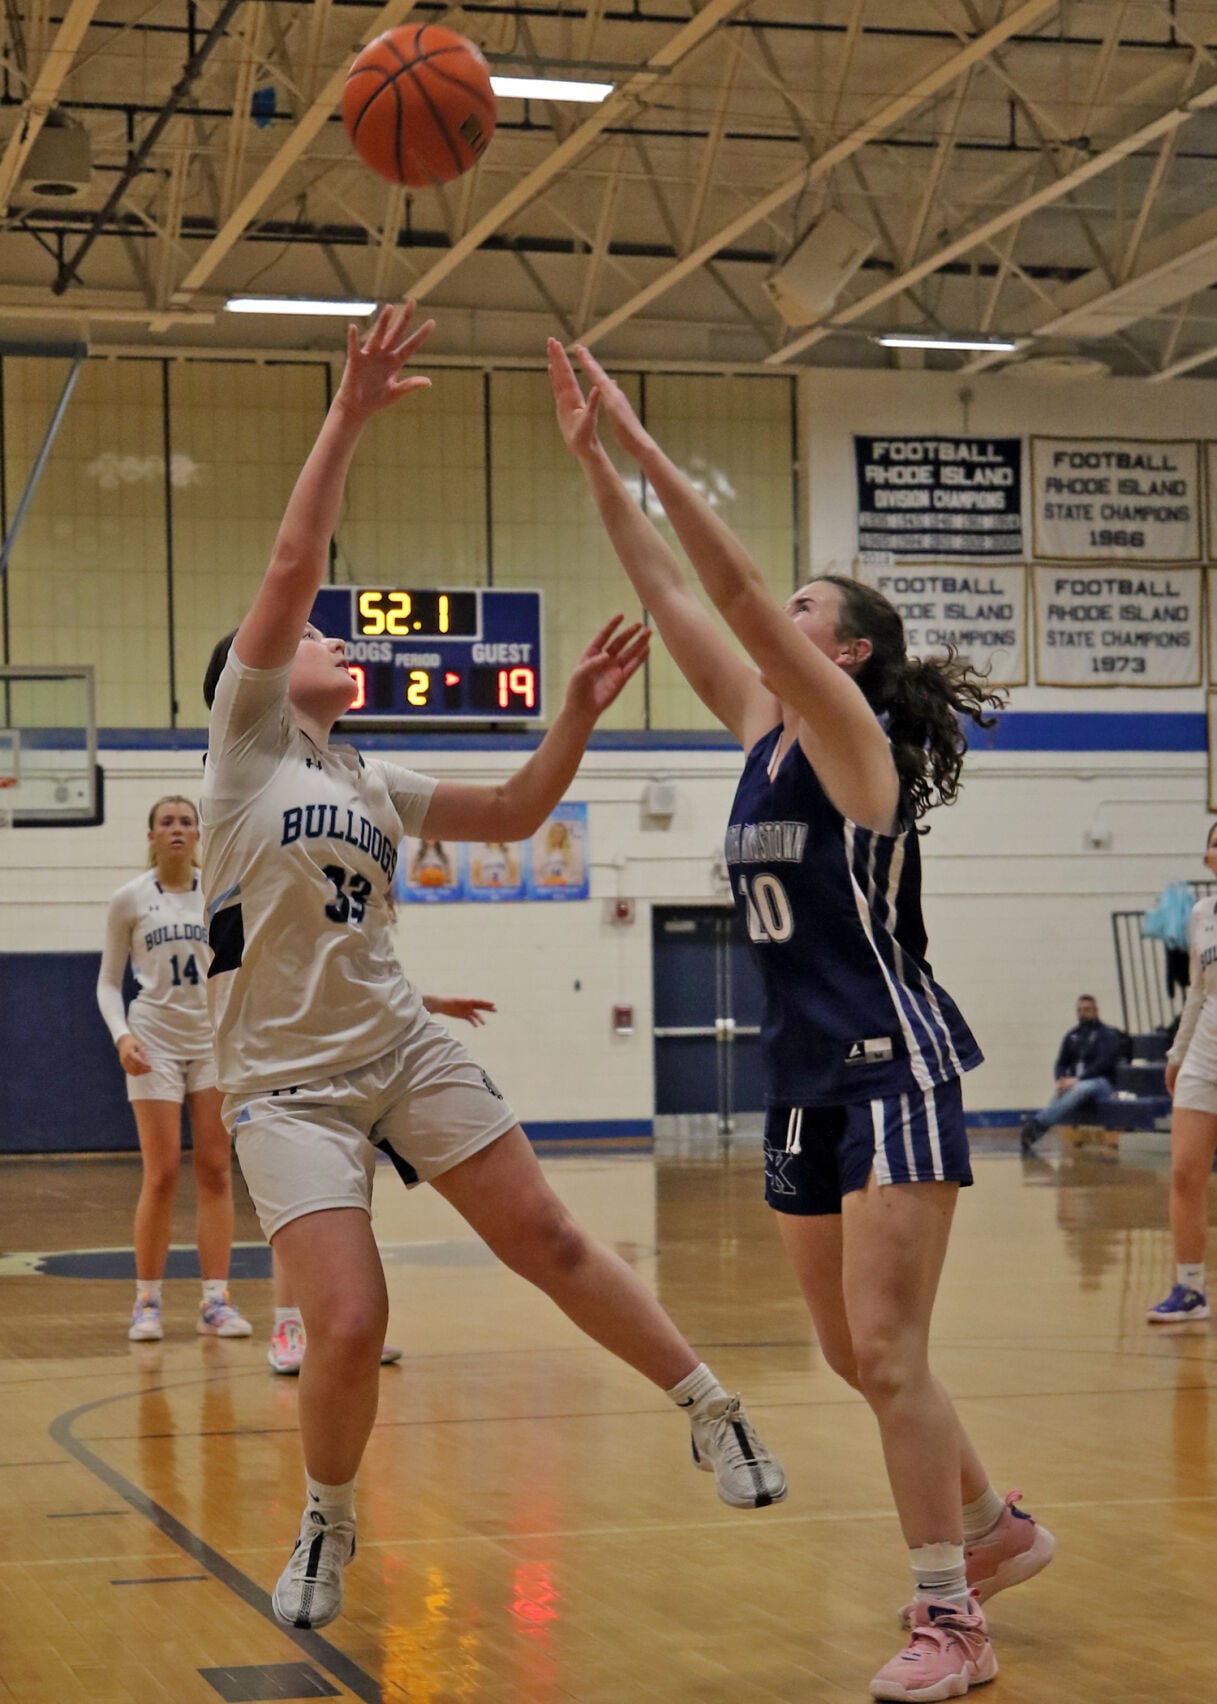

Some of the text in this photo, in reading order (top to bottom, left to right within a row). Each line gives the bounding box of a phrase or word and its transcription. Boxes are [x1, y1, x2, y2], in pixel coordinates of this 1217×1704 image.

[872, 441, 1004, 462] FOOTBALL
[1053, 452, 1178, 471] FOOTBALL
[864, 465, 1013, 486] RHODE ISLAND
[1045, 477, 1187, 496] RHODE ISLAND
[1044, 503, 1190, 522] STATE CHAMPIONS
[878, 577, 1004, 595] FOOTBALL
[1055, 579, 1180, 597] FOOTBALL
[359, 592, 449, 635] 52.1
[944, 603, 1013, 620] ISLAND
[1048, 604, 1188, 622] RHODE ISLAND
[926, 629, 1016, 646] CHAMPIONS
[1047, 631, 1190, 647] STATE CHAMPIONS
[395, 653, 441, 667] PERIOD
[472, 643, 532, 663] GUEST
[1092, 656, 1146, 673] 1973
[407, 671, 429, 705] 2
[498, 668, 535, 708] 19
[281, 804, 398, 885] BULLDOGS
[739, 872, 795, 943] 10
[170, 954, 199, 986] 14
